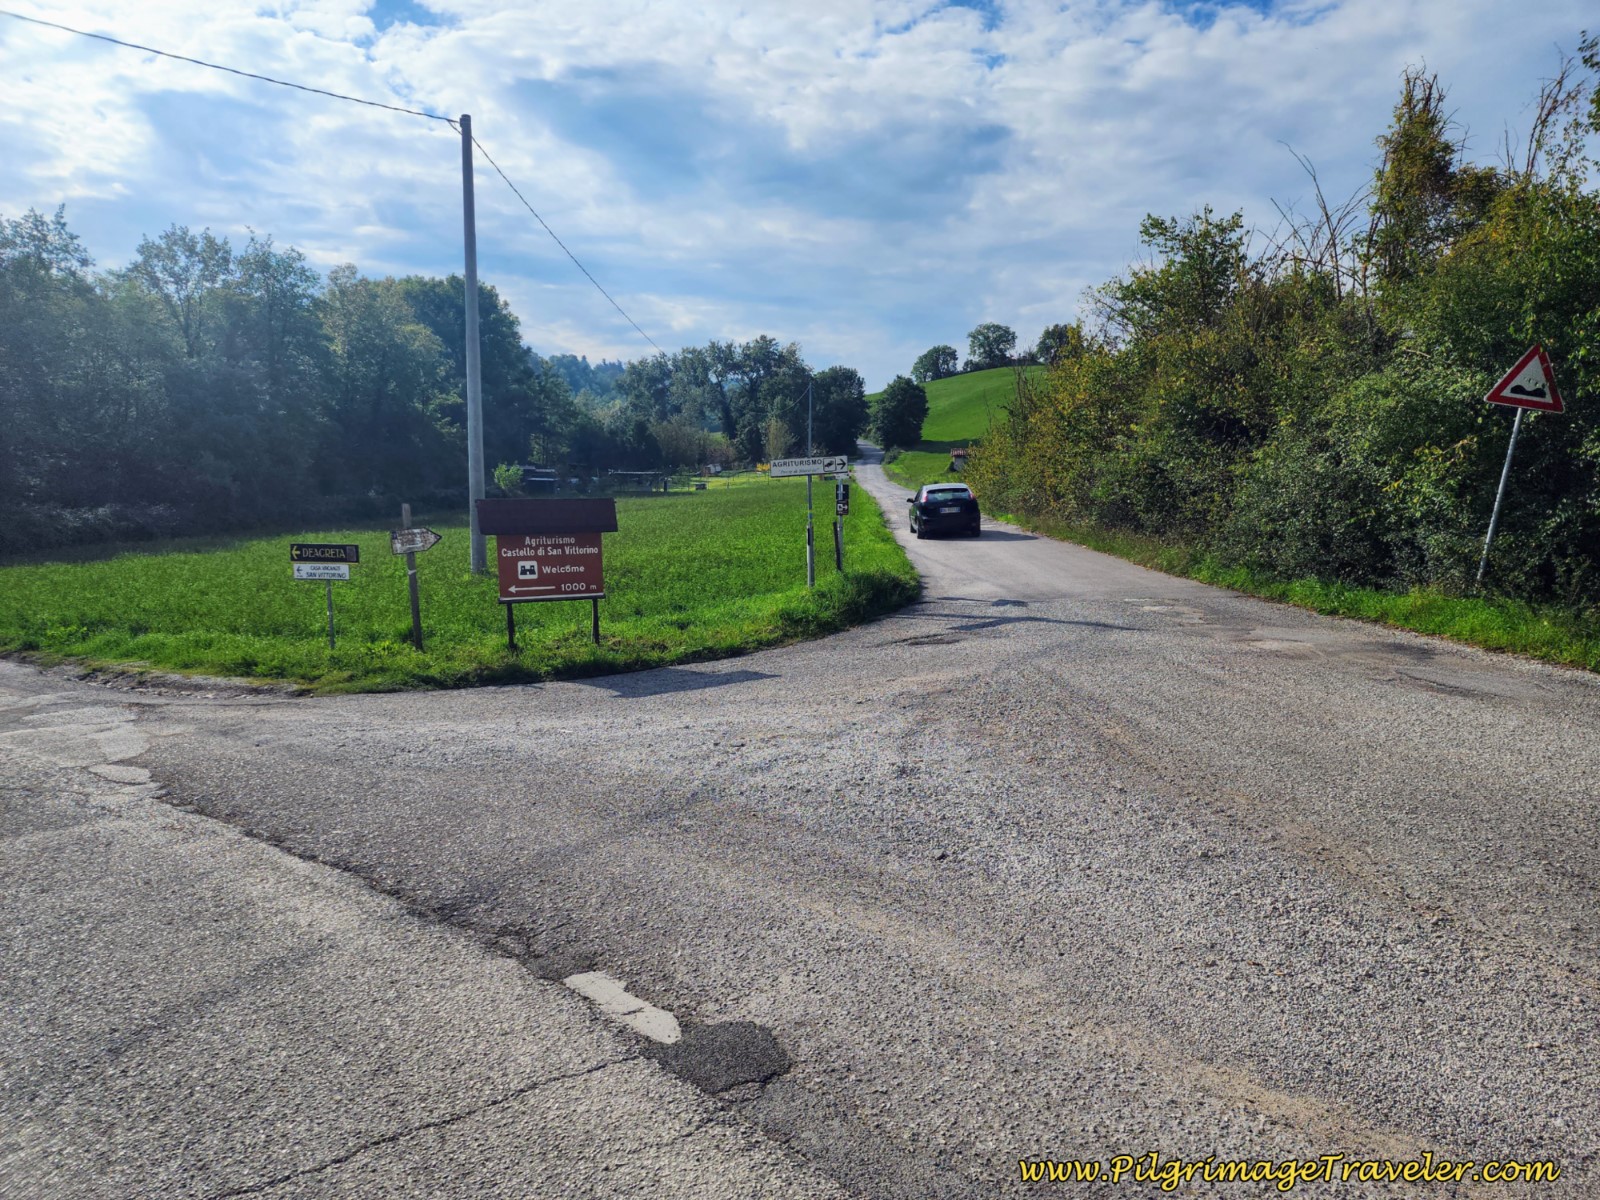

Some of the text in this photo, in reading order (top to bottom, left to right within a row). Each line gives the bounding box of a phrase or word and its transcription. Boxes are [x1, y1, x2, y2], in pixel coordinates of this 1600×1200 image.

[772, 459, 822, 468] AGRITURISMO
[525, 536, 575, 547] Agriturismo
[501, 545, 599, 557] Castello di San Vittorino
[542, 565, 585, 574] Welcome
[561, 582, 586, 591] 1000
